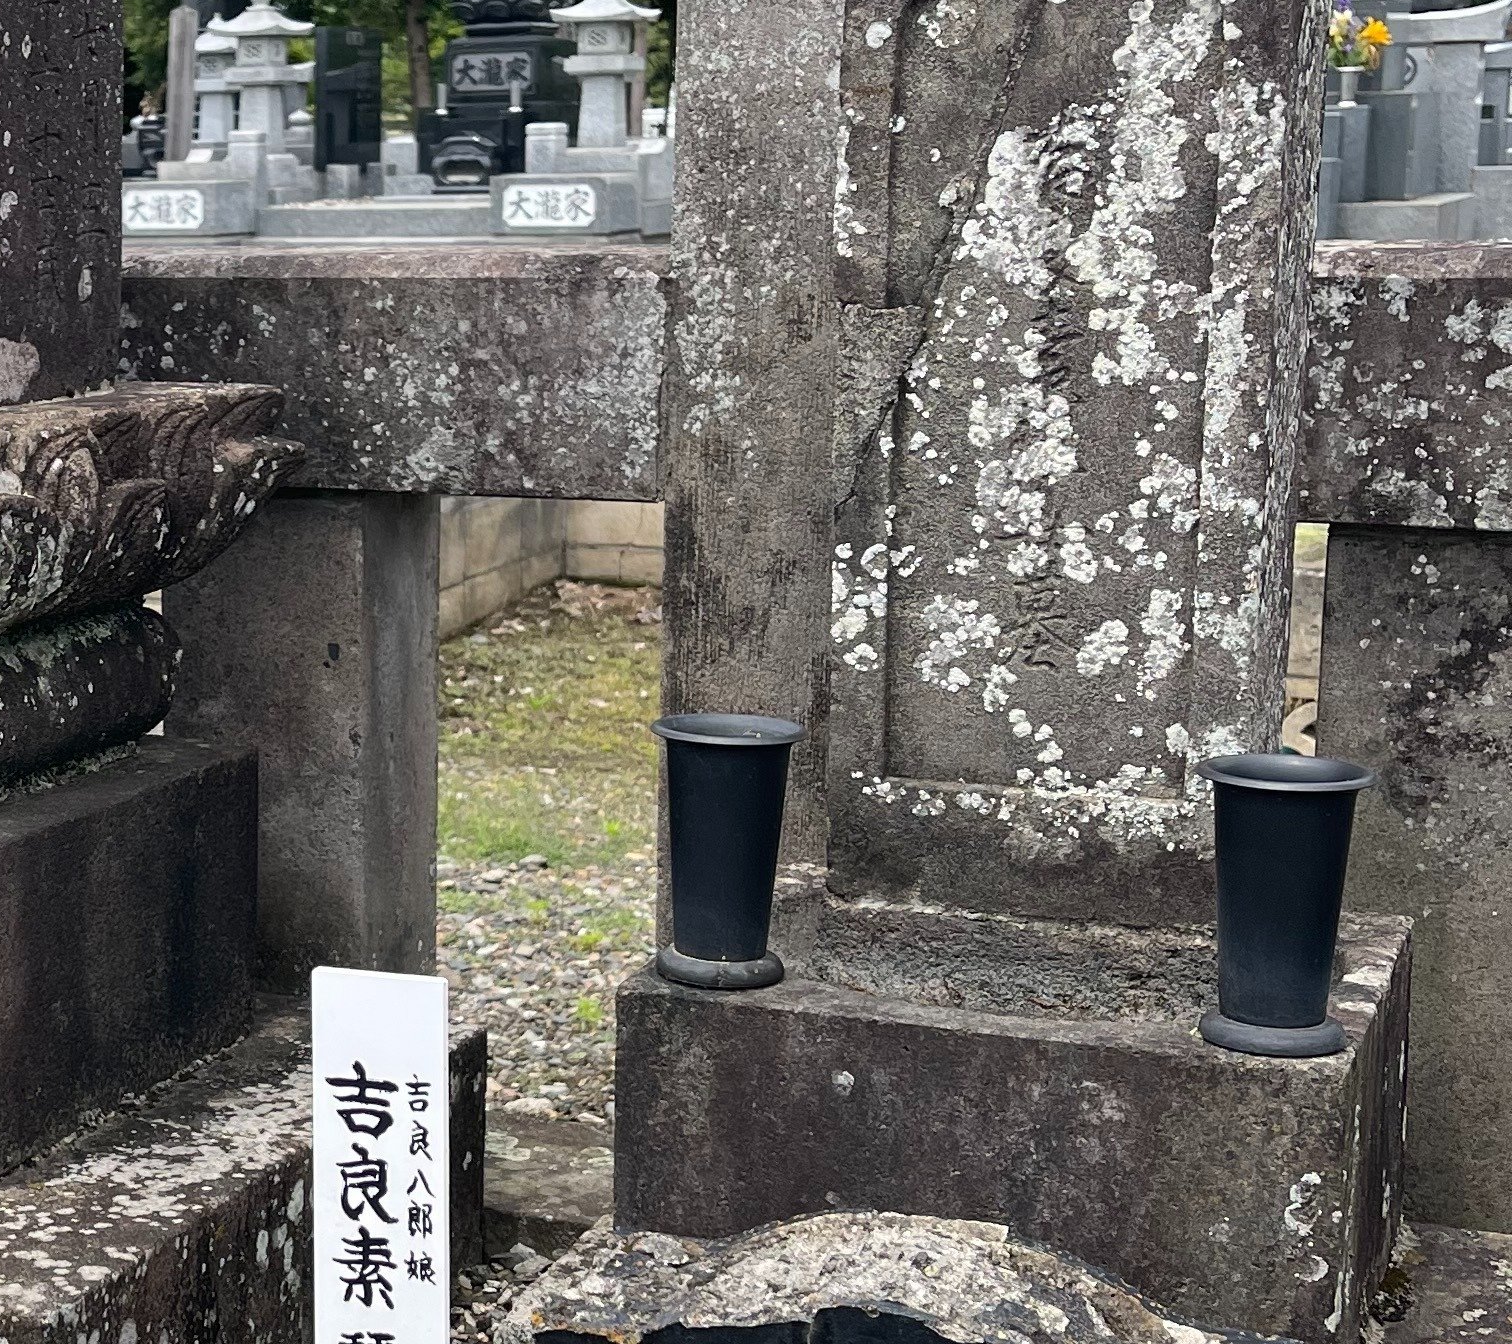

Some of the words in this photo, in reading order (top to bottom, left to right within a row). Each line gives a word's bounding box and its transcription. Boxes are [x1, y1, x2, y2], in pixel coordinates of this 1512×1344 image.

[404, 1074, 436, 1286] 吉良八郎娘
